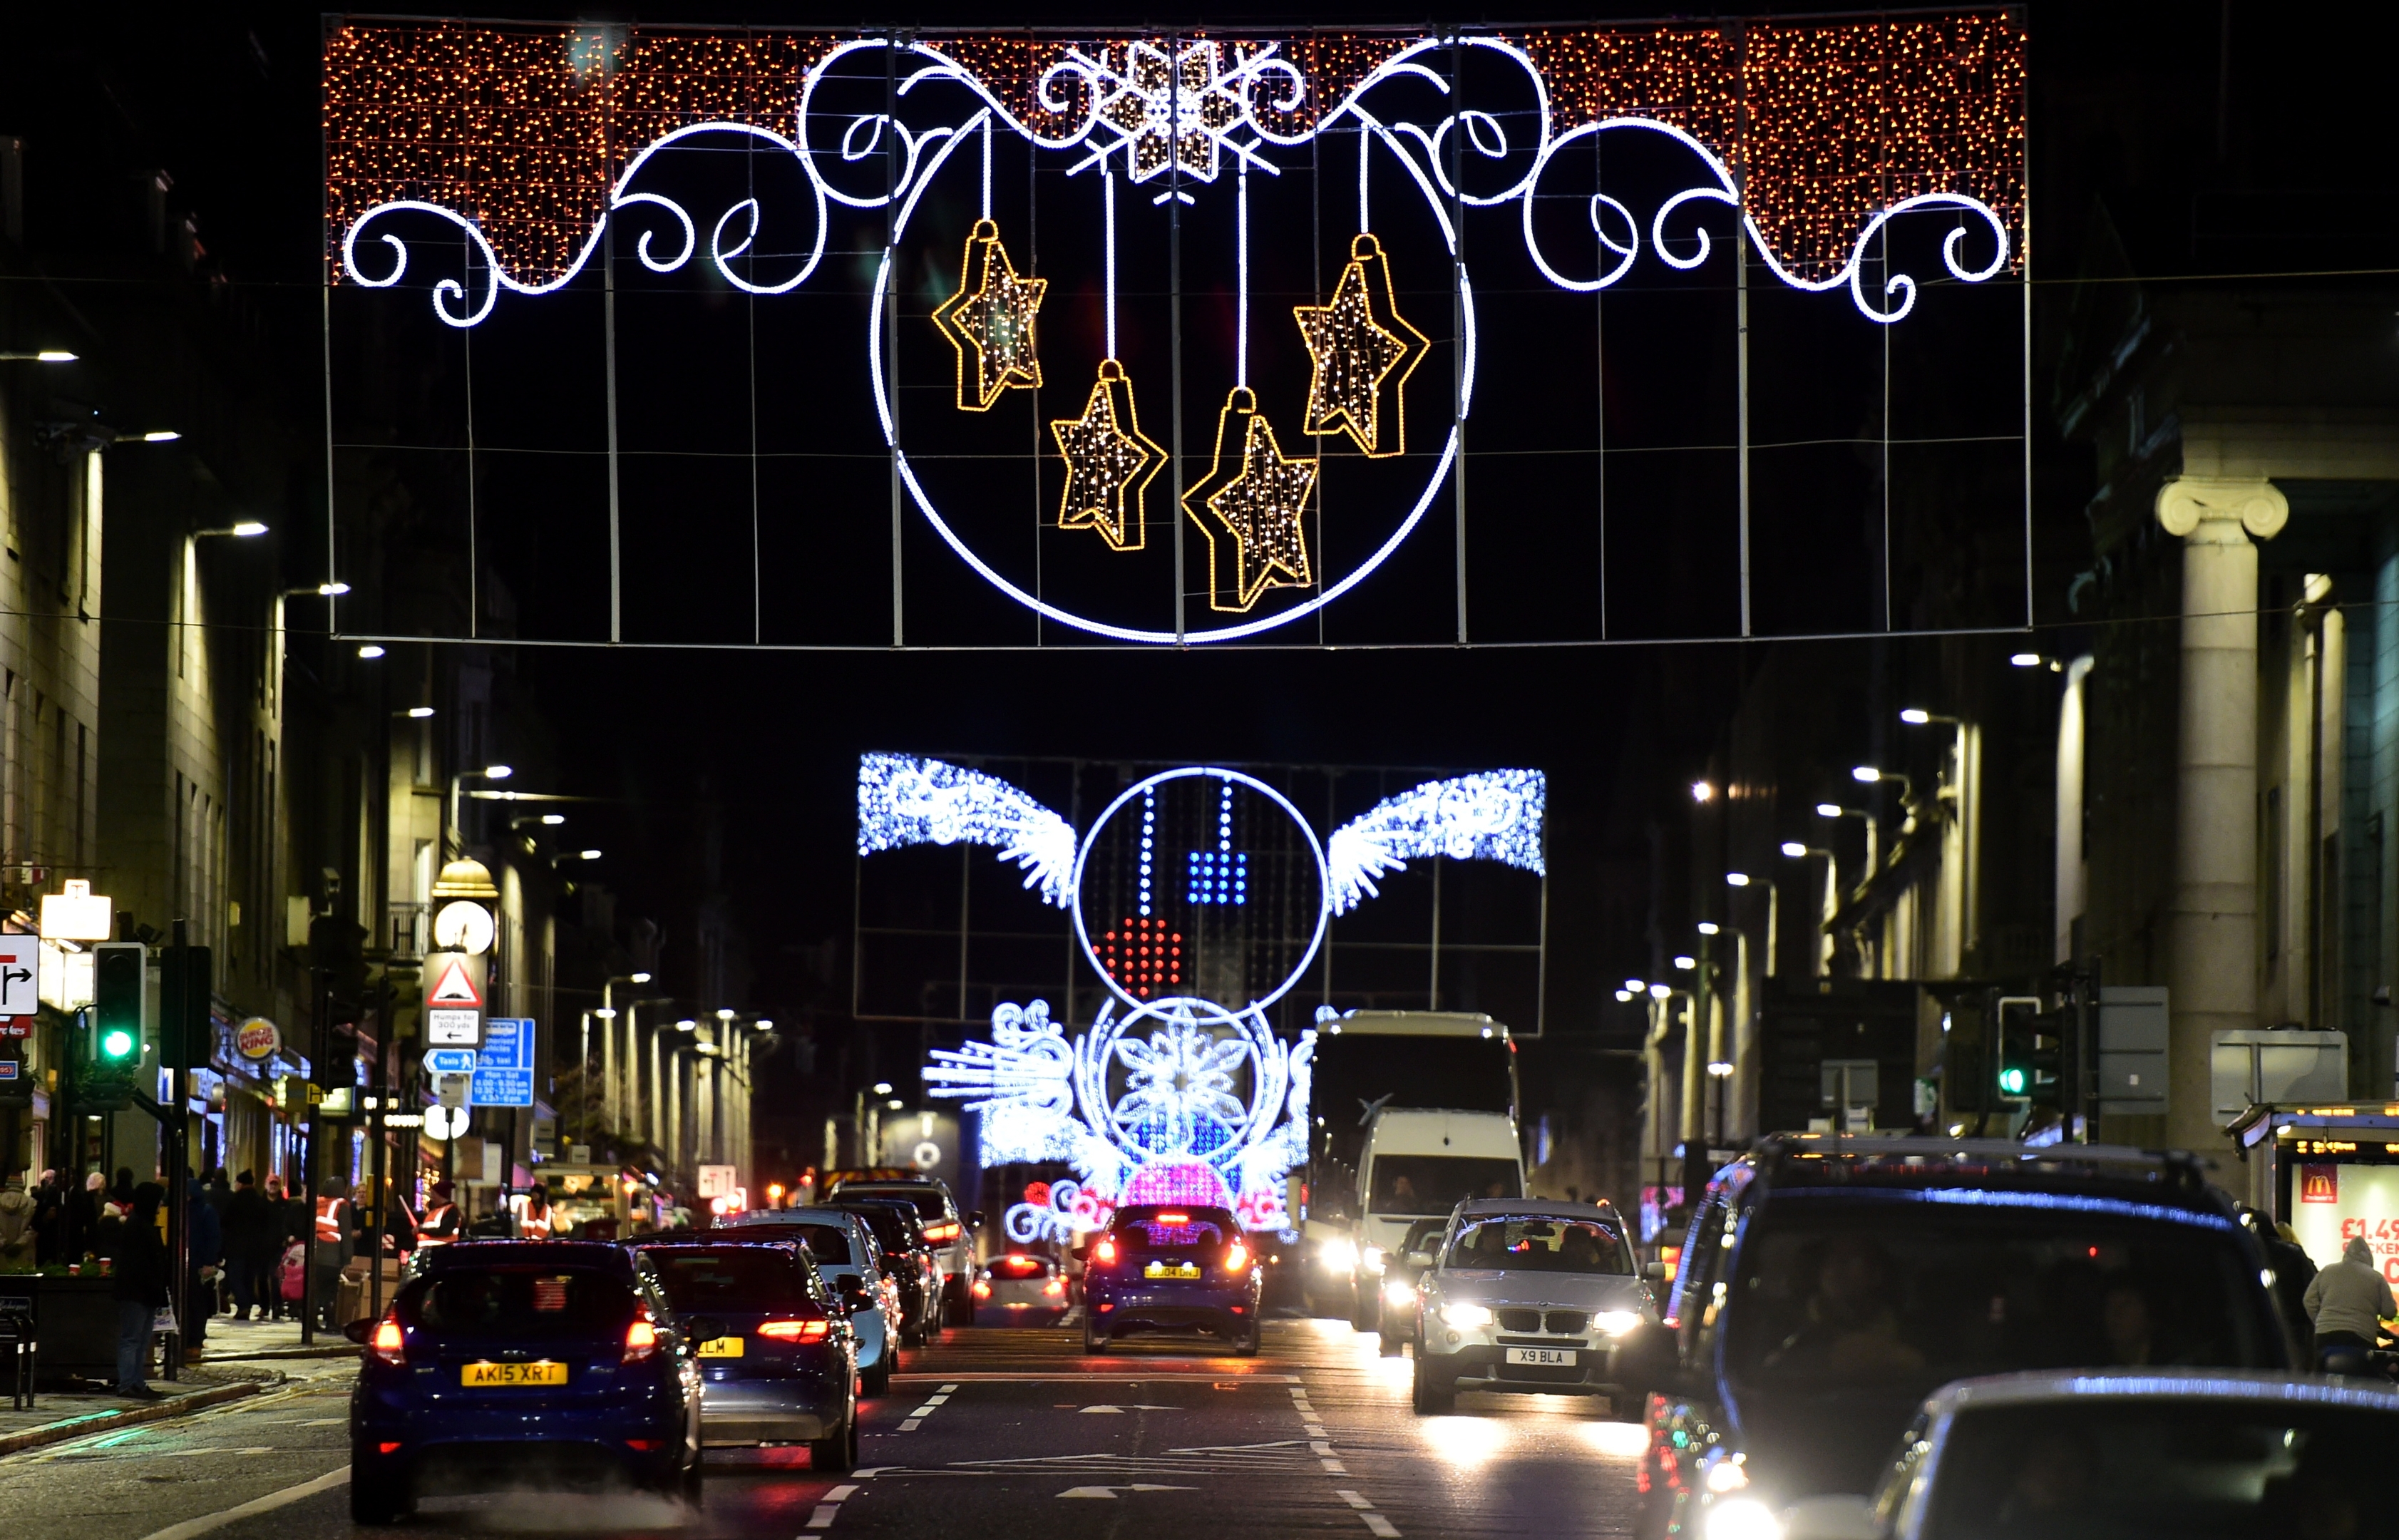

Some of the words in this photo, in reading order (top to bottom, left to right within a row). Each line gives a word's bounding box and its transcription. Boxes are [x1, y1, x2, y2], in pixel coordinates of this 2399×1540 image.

[240, 1036, 274, 1052] KING
[438, 1057, 459, 1065] Taxis
[2341, 1218, 2399, 1240] £1.49
[698, 1340, 725, 1353] LM
[1521, 1350, 1536, 1362] X9
[1539, 1351, 1563, 1363] BLA
[475, 1365, 514, 1382] AK15
[520, 1365, 555, 1380] XRT
